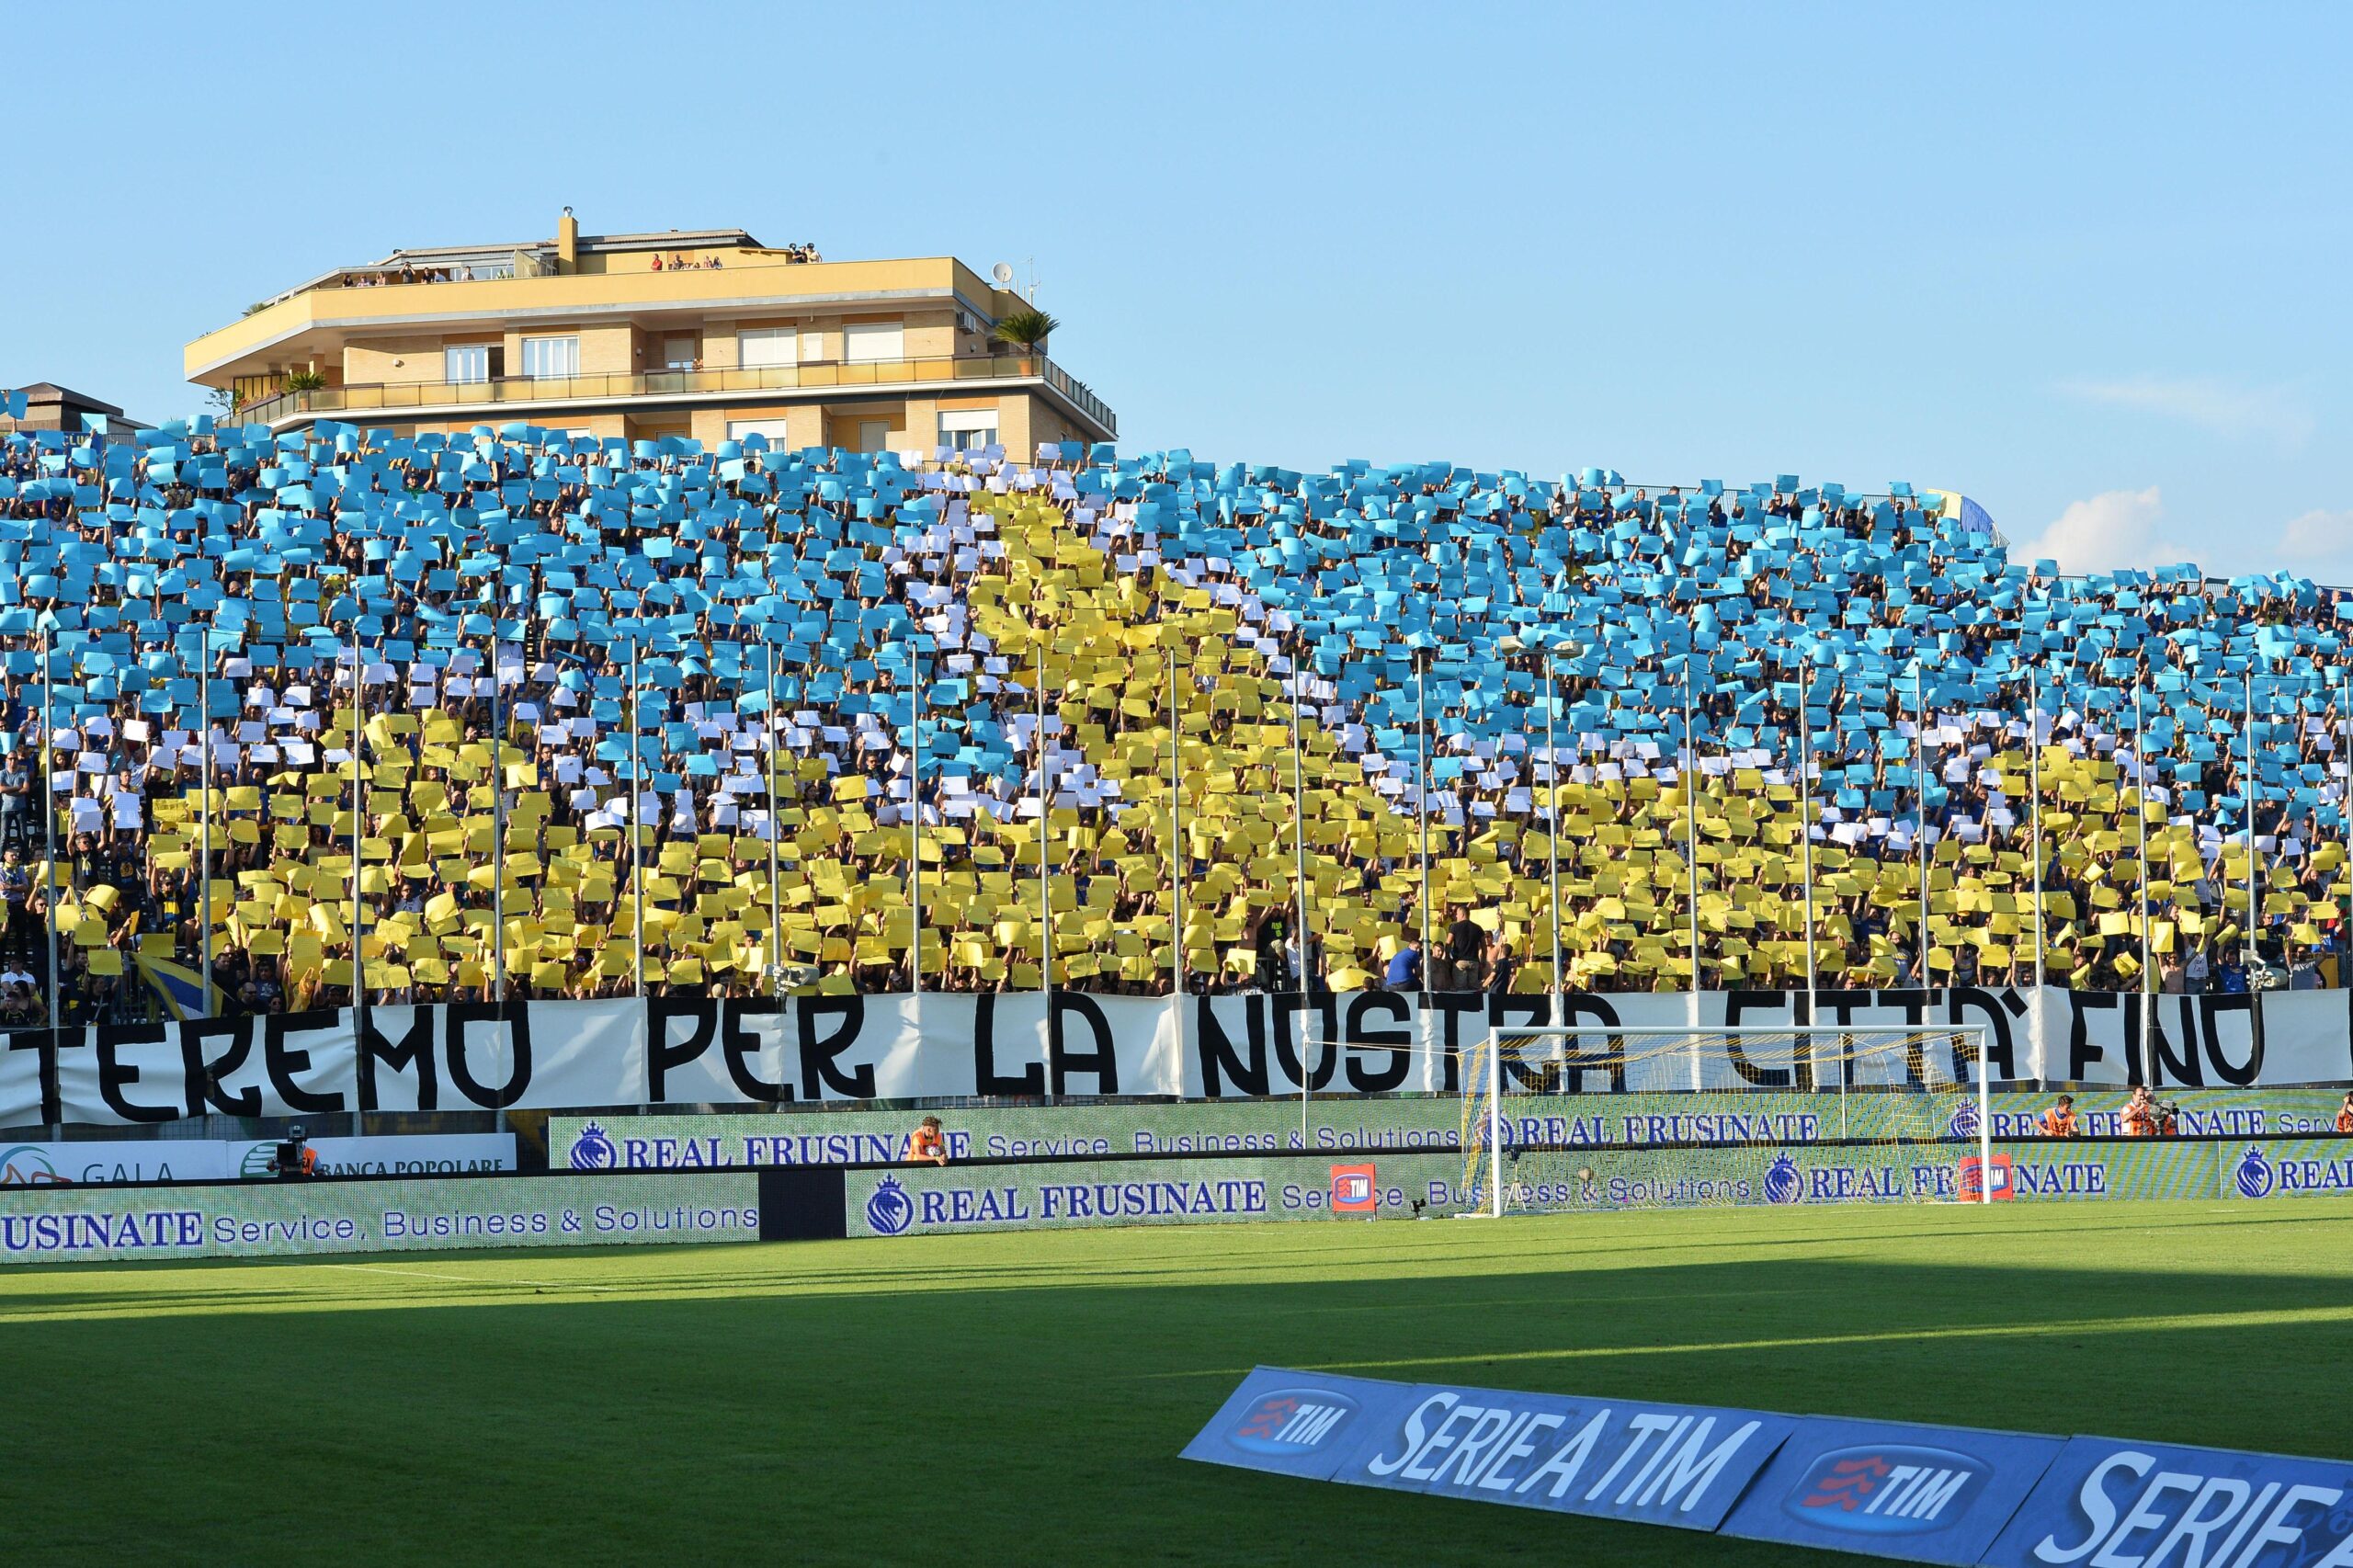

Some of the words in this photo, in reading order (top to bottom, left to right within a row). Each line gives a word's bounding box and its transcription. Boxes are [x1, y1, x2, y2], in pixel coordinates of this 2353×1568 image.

[647, 994, 876, 1102] PER
[975, 993, 1119, 1095] LA
[1198, 992, 1626, 1096] NOSTRA
[2069, 990, 2266, 1087] FINO
[624, 1136, 732, 1167] REAL
[1135, 1131, 1275, 1153] Business
[1289, 1130, 1304, 1149] &
[1317, 1126, 1459, 1149] Solutions
[1521, 1116, 1613, 1144] REAL
[1623, 1114, 1818, 1142] FRUSINATE
[921, 1187, 1029, 1223] REAL
[1040, 1181, 1266, 1220] FRUSINATE
[1350, 1179, 1368, 1198] TIM
[1810, 1166, 1903, 1198] REAL
[214, 1215, 367, 1243] Service,
[384, 1210, 547, 1237] Business
[561, 1210, 582, 1233] &
[596, 1204, 758, 1232] Solutions
[1274, 1403, 1347, 1446] TIM
[1368, 1392, 1565, 1490] SERIE
[1516, 1408, 1610, 1498] A
[1586, 1414, 1762, 1512] TIM
[1863, 1465, 1972, 1521] TIM
